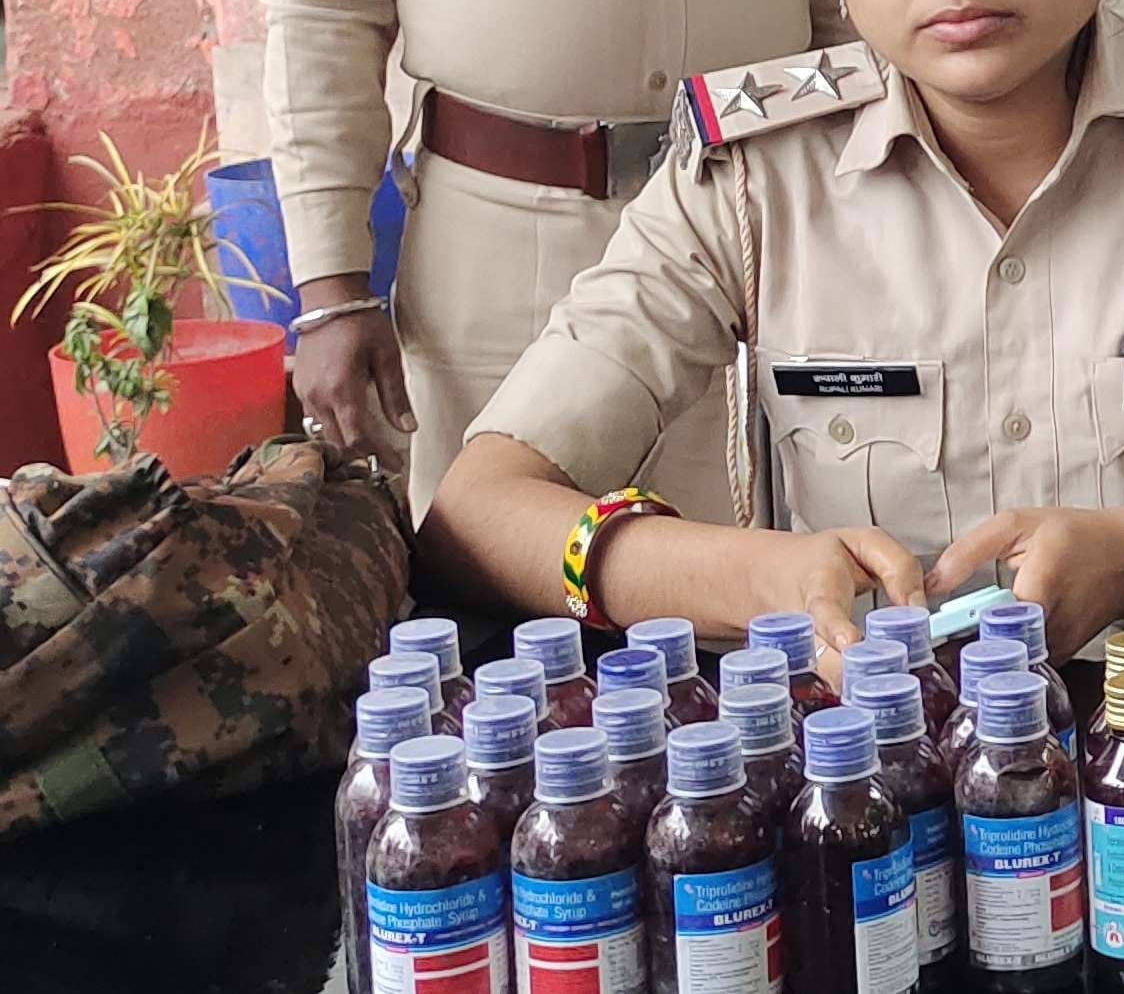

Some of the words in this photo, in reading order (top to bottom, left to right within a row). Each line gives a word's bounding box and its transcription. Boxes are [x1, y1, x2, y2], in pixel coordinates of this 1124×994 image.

[994, 851, 1062, 870] BLUREX-T
[586, 888, 597, 903] &
[448, 907, 479, 926] Syrup
[554, 905, 587, 922] Syrup
